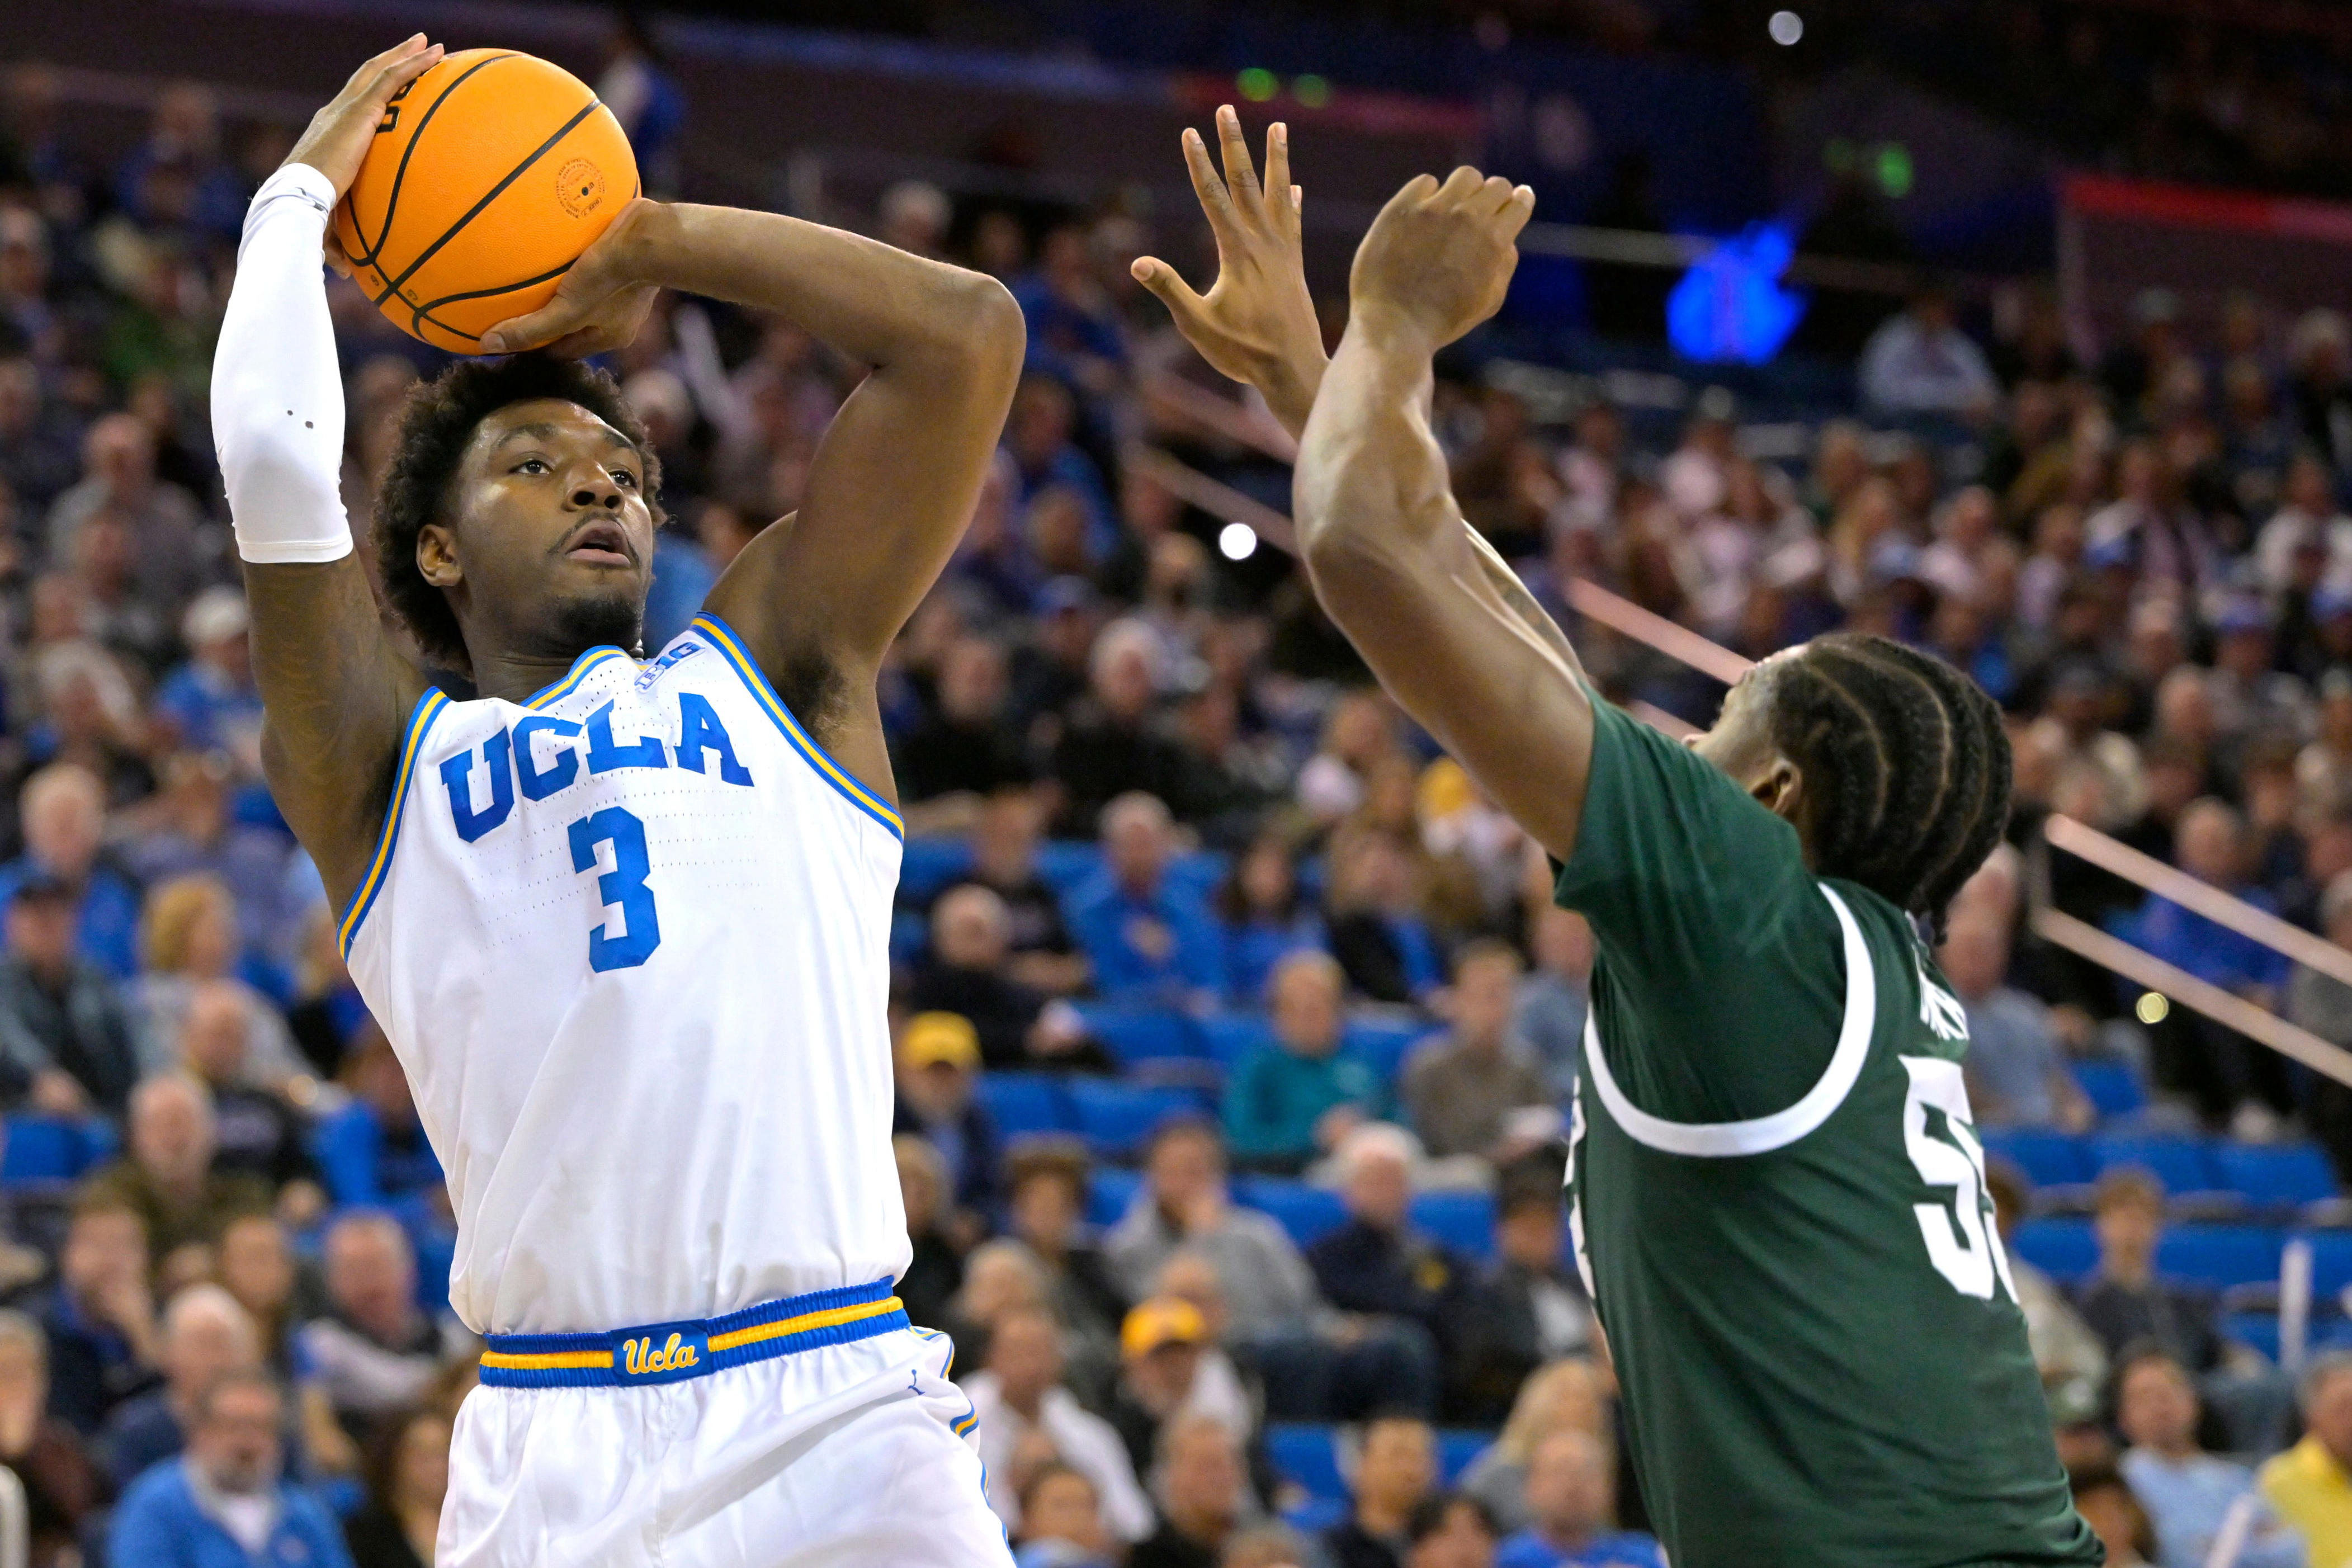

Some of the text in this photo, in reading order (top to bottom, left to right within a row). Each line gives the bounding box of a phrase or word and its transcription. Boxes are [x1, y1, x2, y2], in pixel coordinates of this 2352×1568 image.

[440, 692, 755, 843] UCLA
[568, 806, 661, 974] 3
[623, 1333, 700, 1375] Ucla
